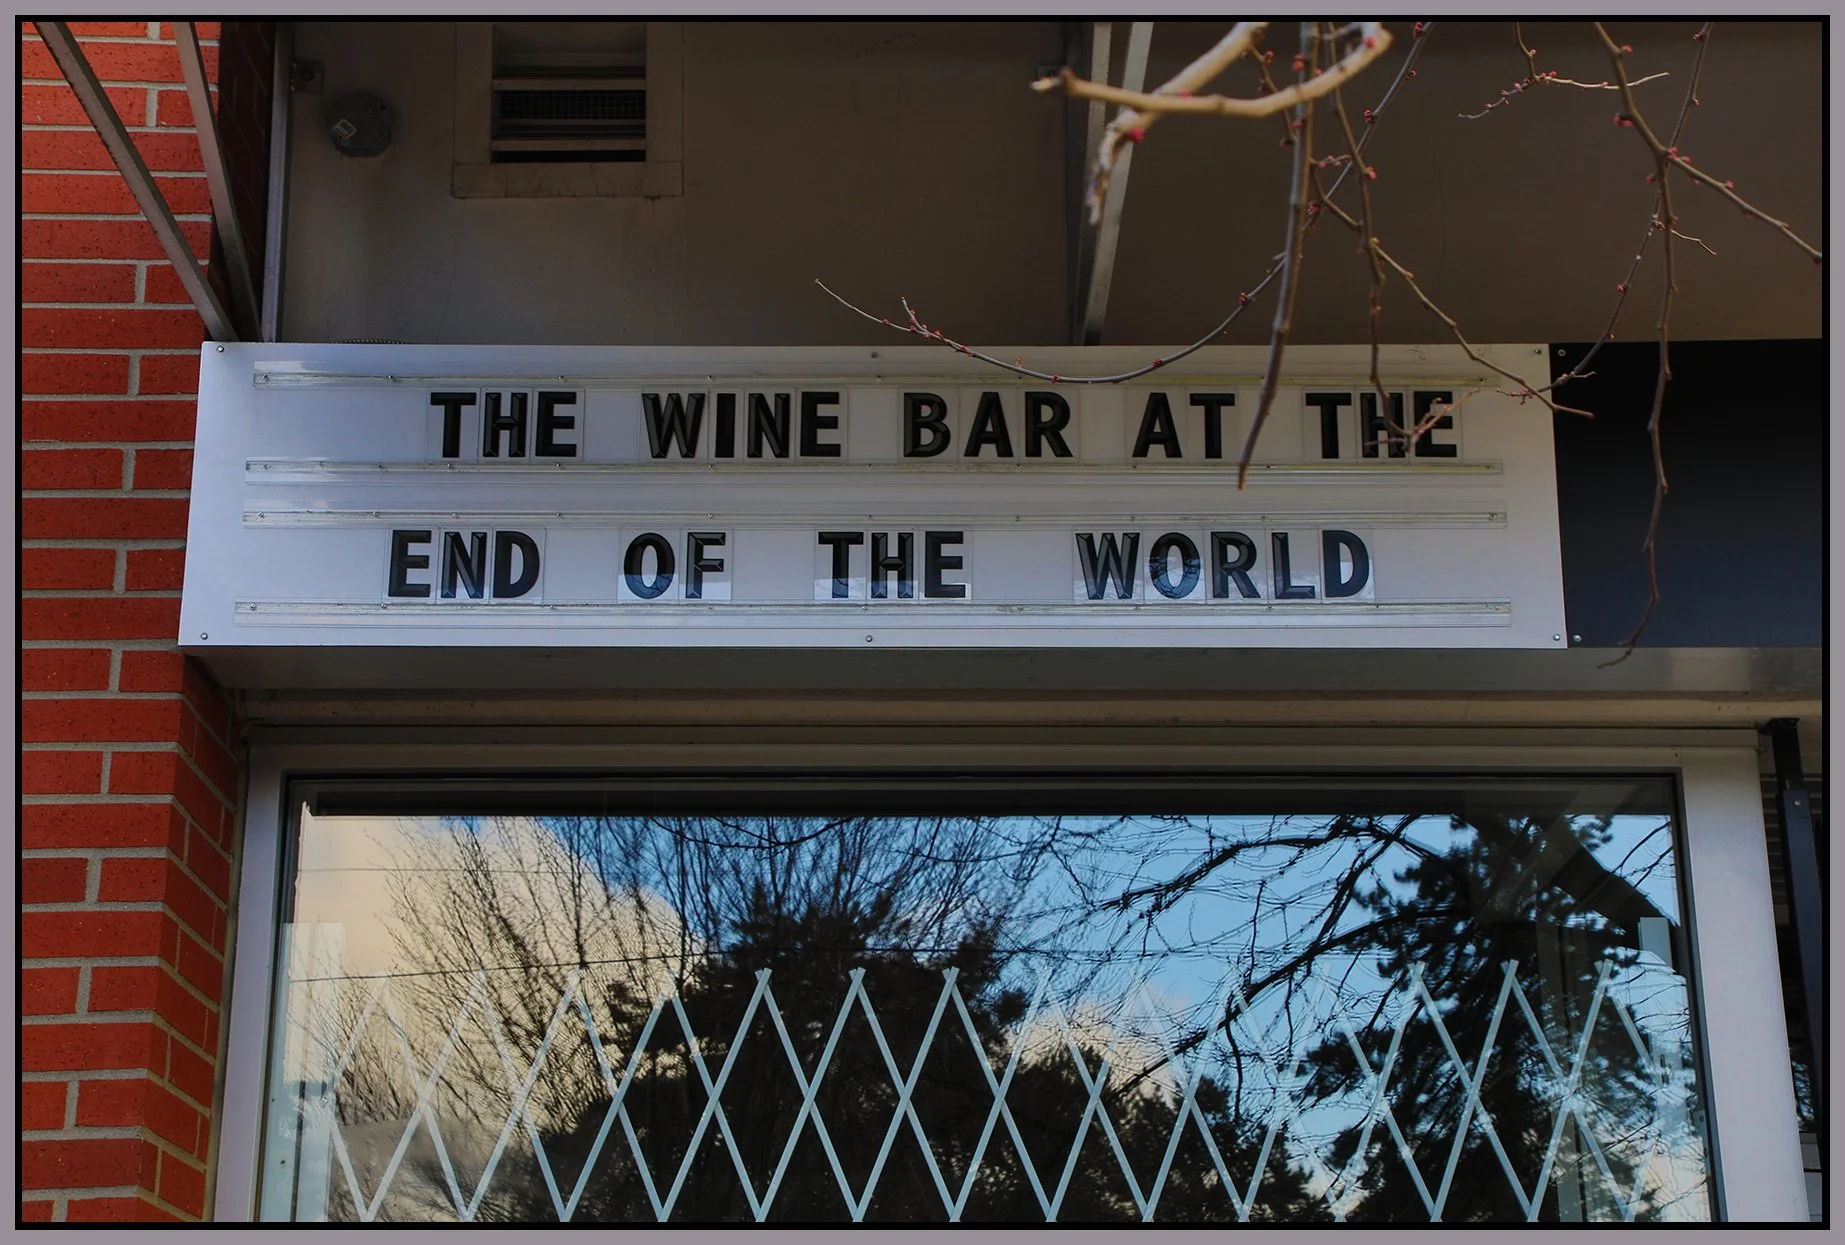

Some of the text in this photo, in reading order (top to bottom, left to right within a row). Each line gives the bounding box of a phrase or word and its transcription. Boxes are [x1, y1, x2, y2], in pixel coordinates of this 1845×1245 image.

[430, 390, 1457, 459] THE WINE BAR AT THE
[388, 530, 1370, 600] END OF THE WORLD
